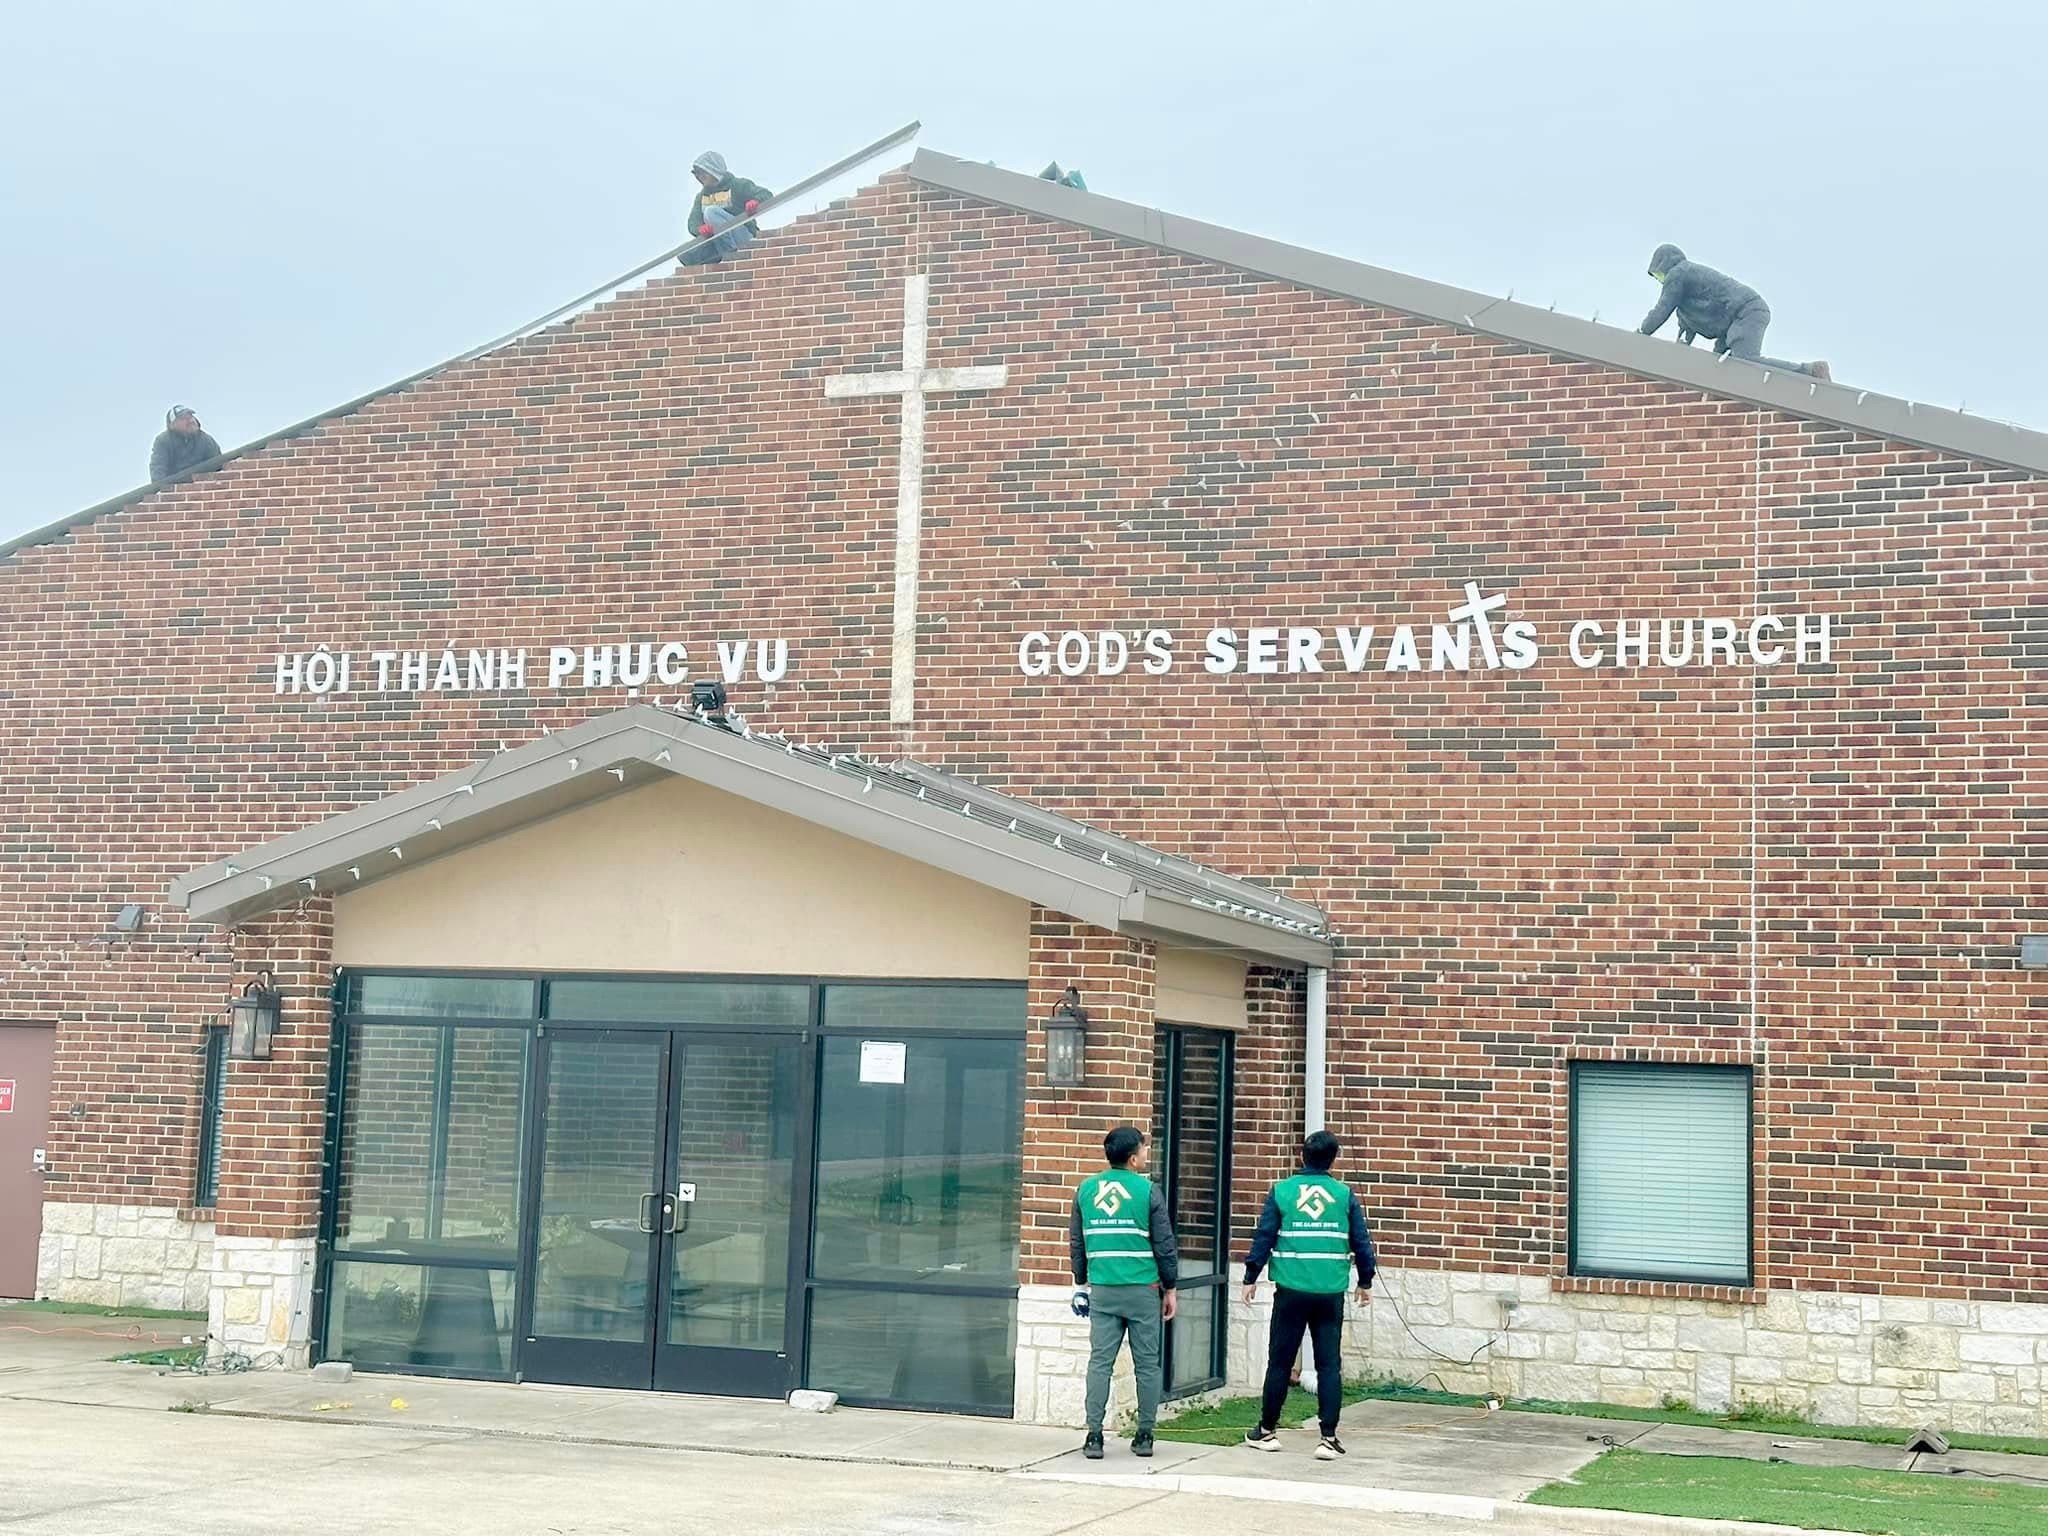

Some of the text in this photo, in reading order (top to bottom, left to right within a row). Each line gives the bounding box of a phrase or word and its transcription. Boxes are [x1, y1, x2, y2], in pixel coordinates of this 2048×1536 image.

[1204, 580, 1538, 674] SERVANTS
[1568, 614, 1832, 669] CHURCH
[371, 640, 527, 692] THÁNH
